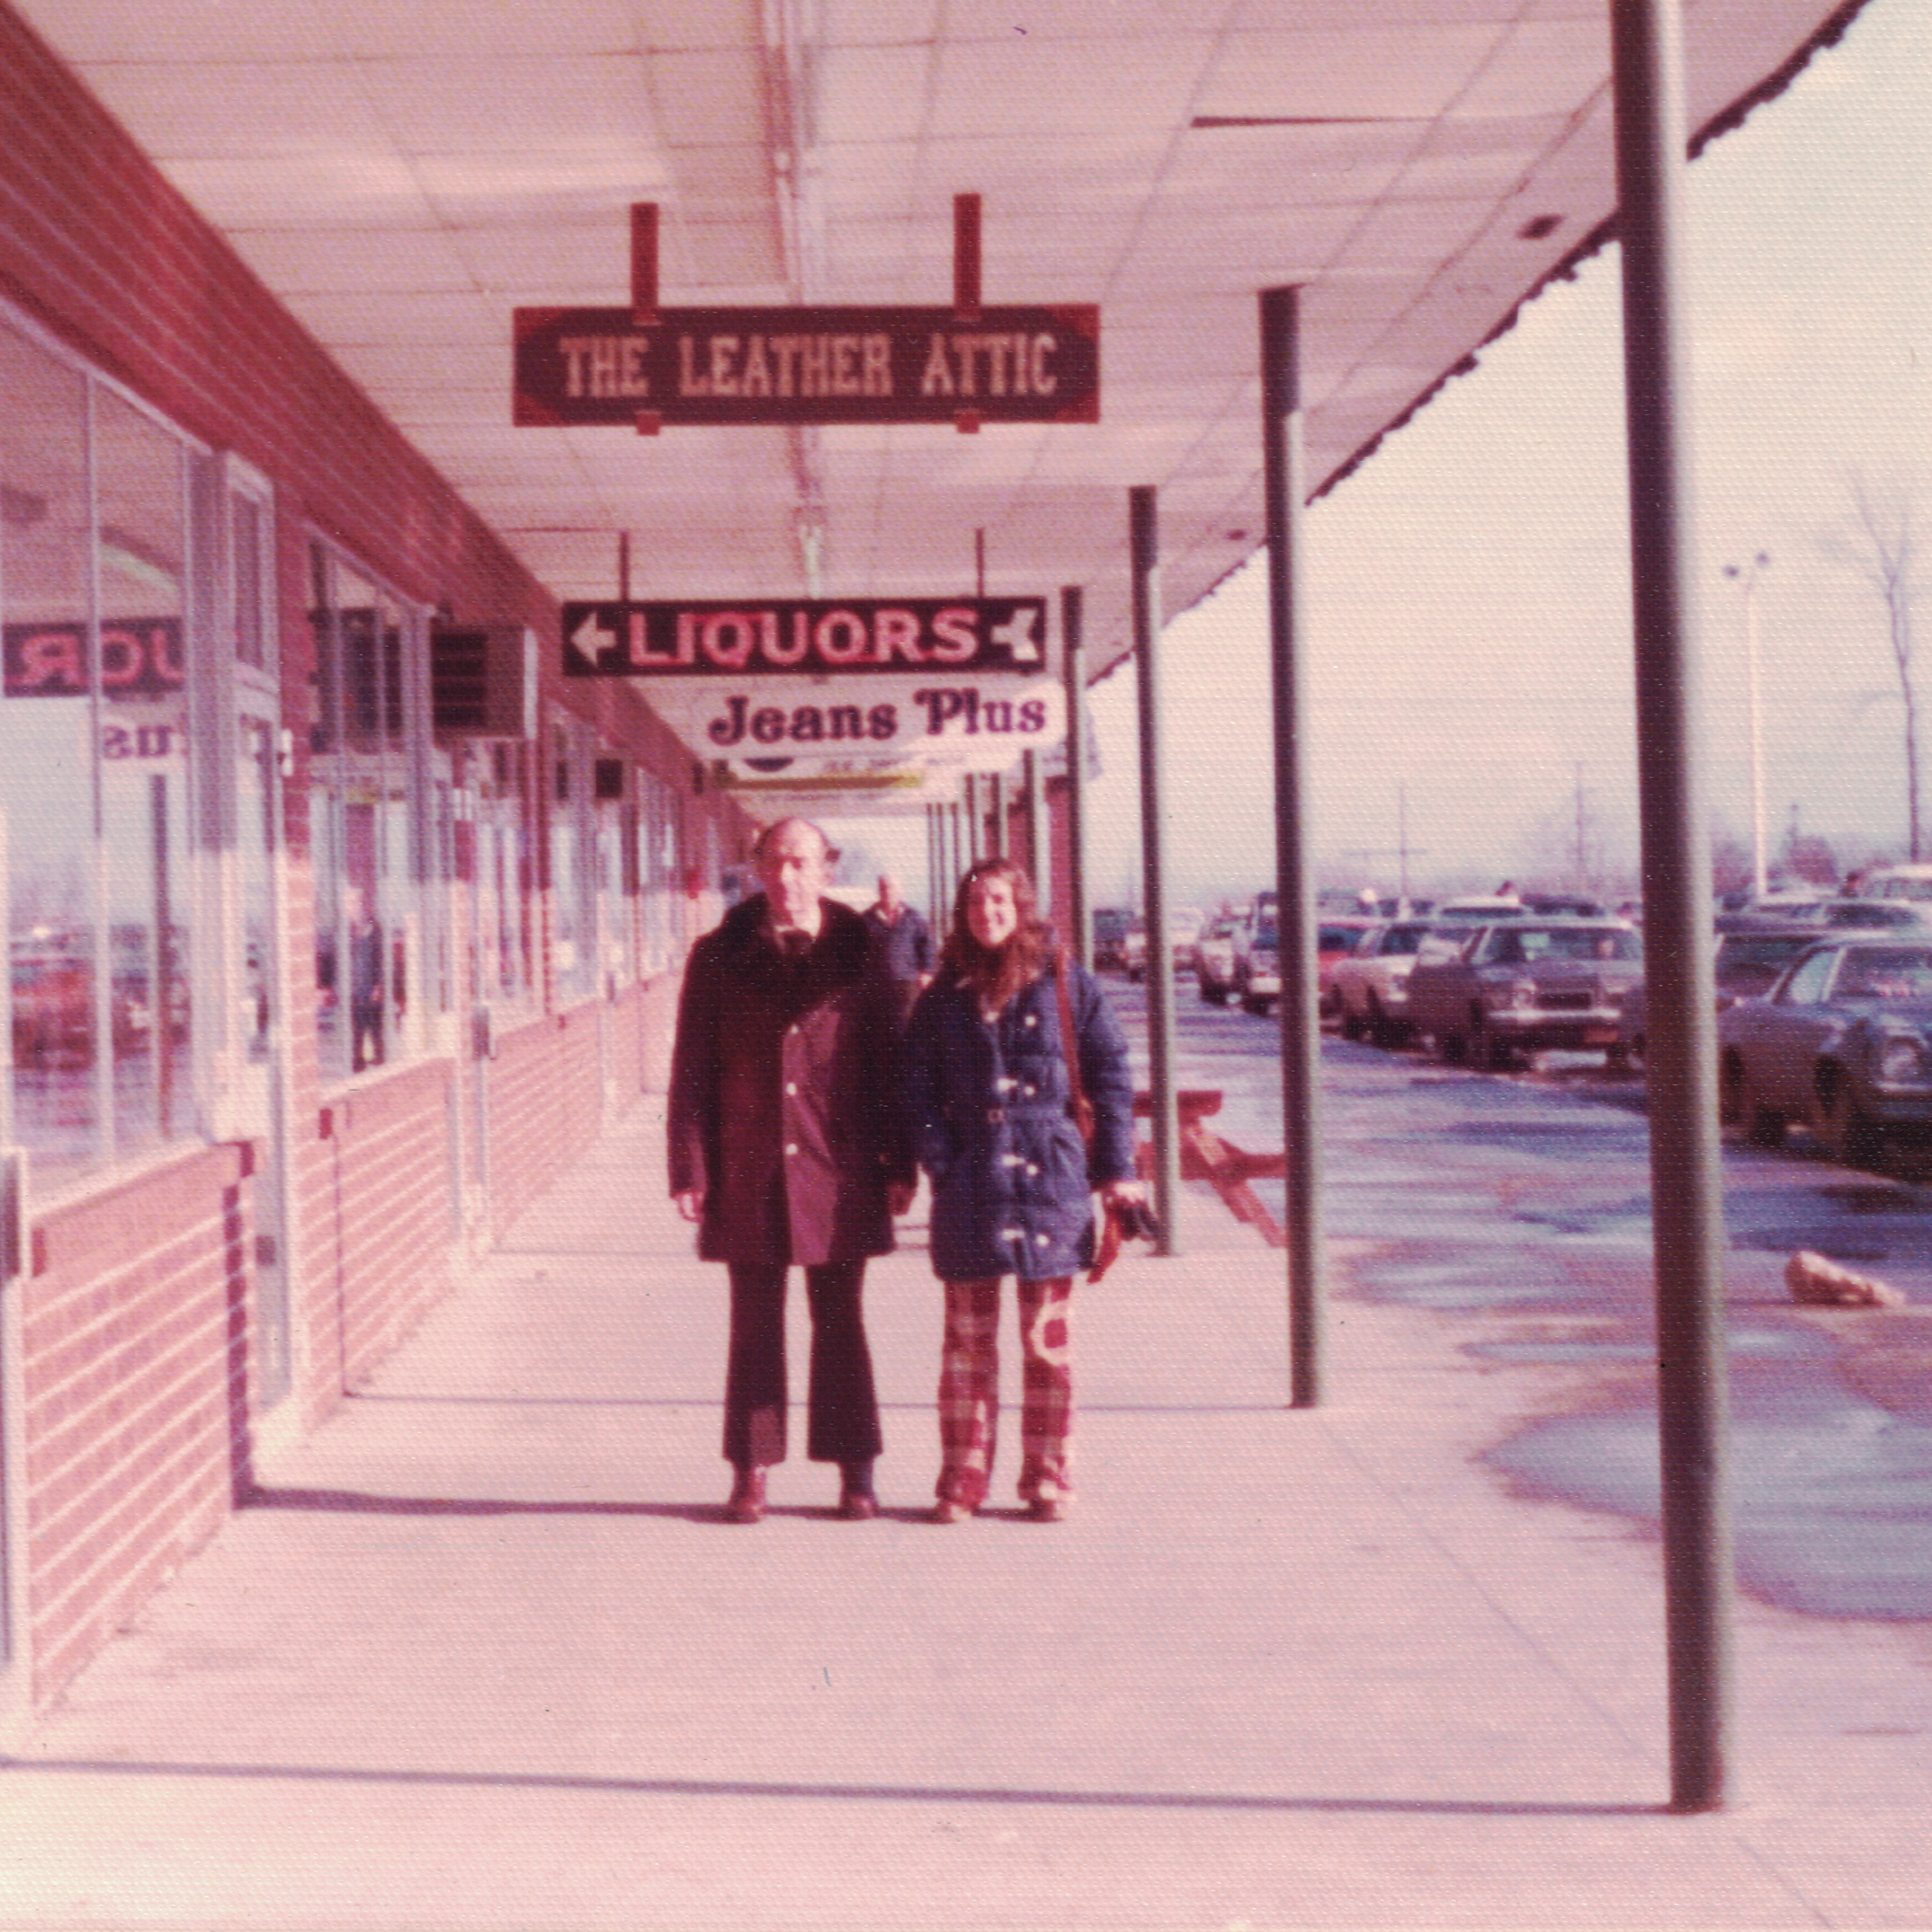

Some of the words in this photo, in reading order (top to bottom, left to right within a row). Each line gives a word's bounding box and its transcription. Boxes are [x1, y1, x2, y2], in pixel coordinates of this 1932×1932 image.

[560, 336, 649, 396] THE
[678, 334, 893, 396] LEATHER
[922, 333, 1057, 396] ATTIC
[628, 608, 979, 667] LIQUORS
[707, 695, 898, 747] Jeans
[913, 687, 1046, 734] Plus
